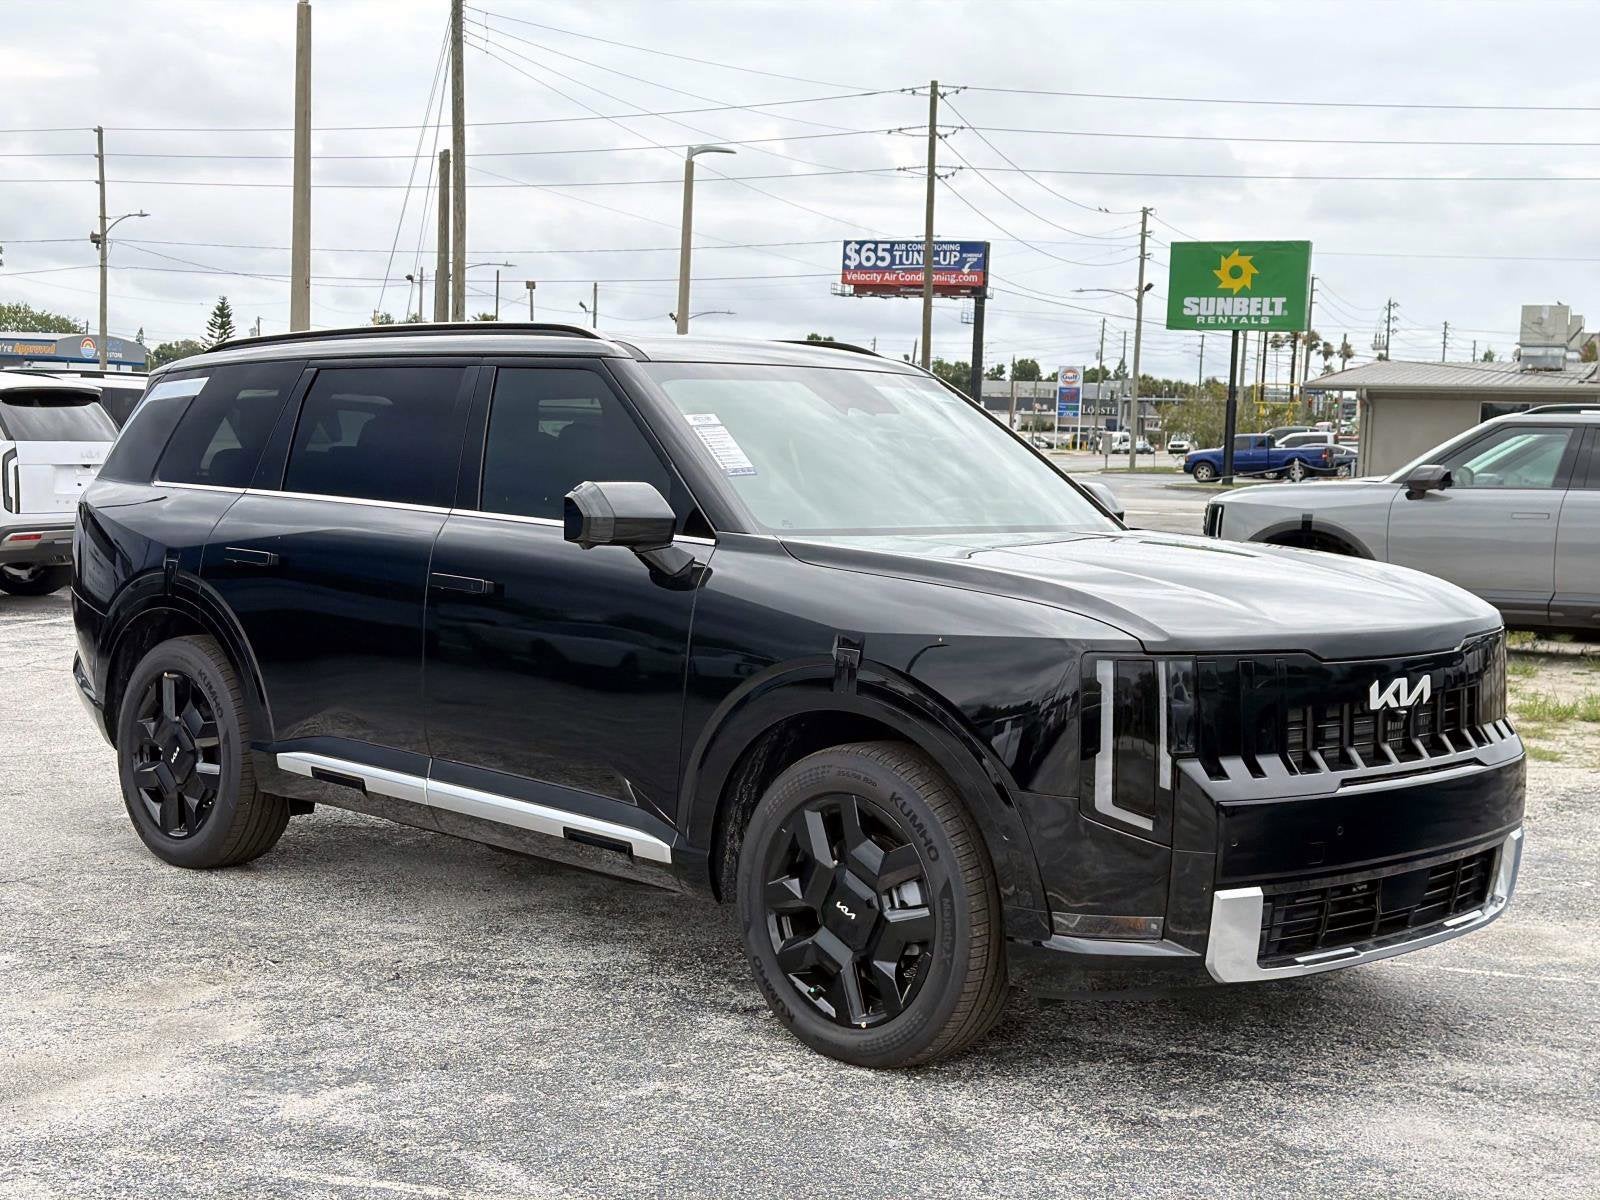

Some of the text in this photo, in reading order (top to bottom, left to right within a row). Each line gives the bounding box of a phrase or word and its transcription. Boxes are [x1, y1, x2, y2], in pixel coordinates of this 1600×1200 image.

[844, 241, 891, 269] $65
[893, 243, 907, 251] AIR
[893, 251, 960, 265] TUN-UP
[846, 272, 978, 283] Velocity Air Condioning.com
[1182, 297, 1287, 316] SUNBELT
[1196, 316, 1270, 324] RENTALS
[1369, 674, 1432, 711] KIA
[890, 791, 940, 862] KUMHO
